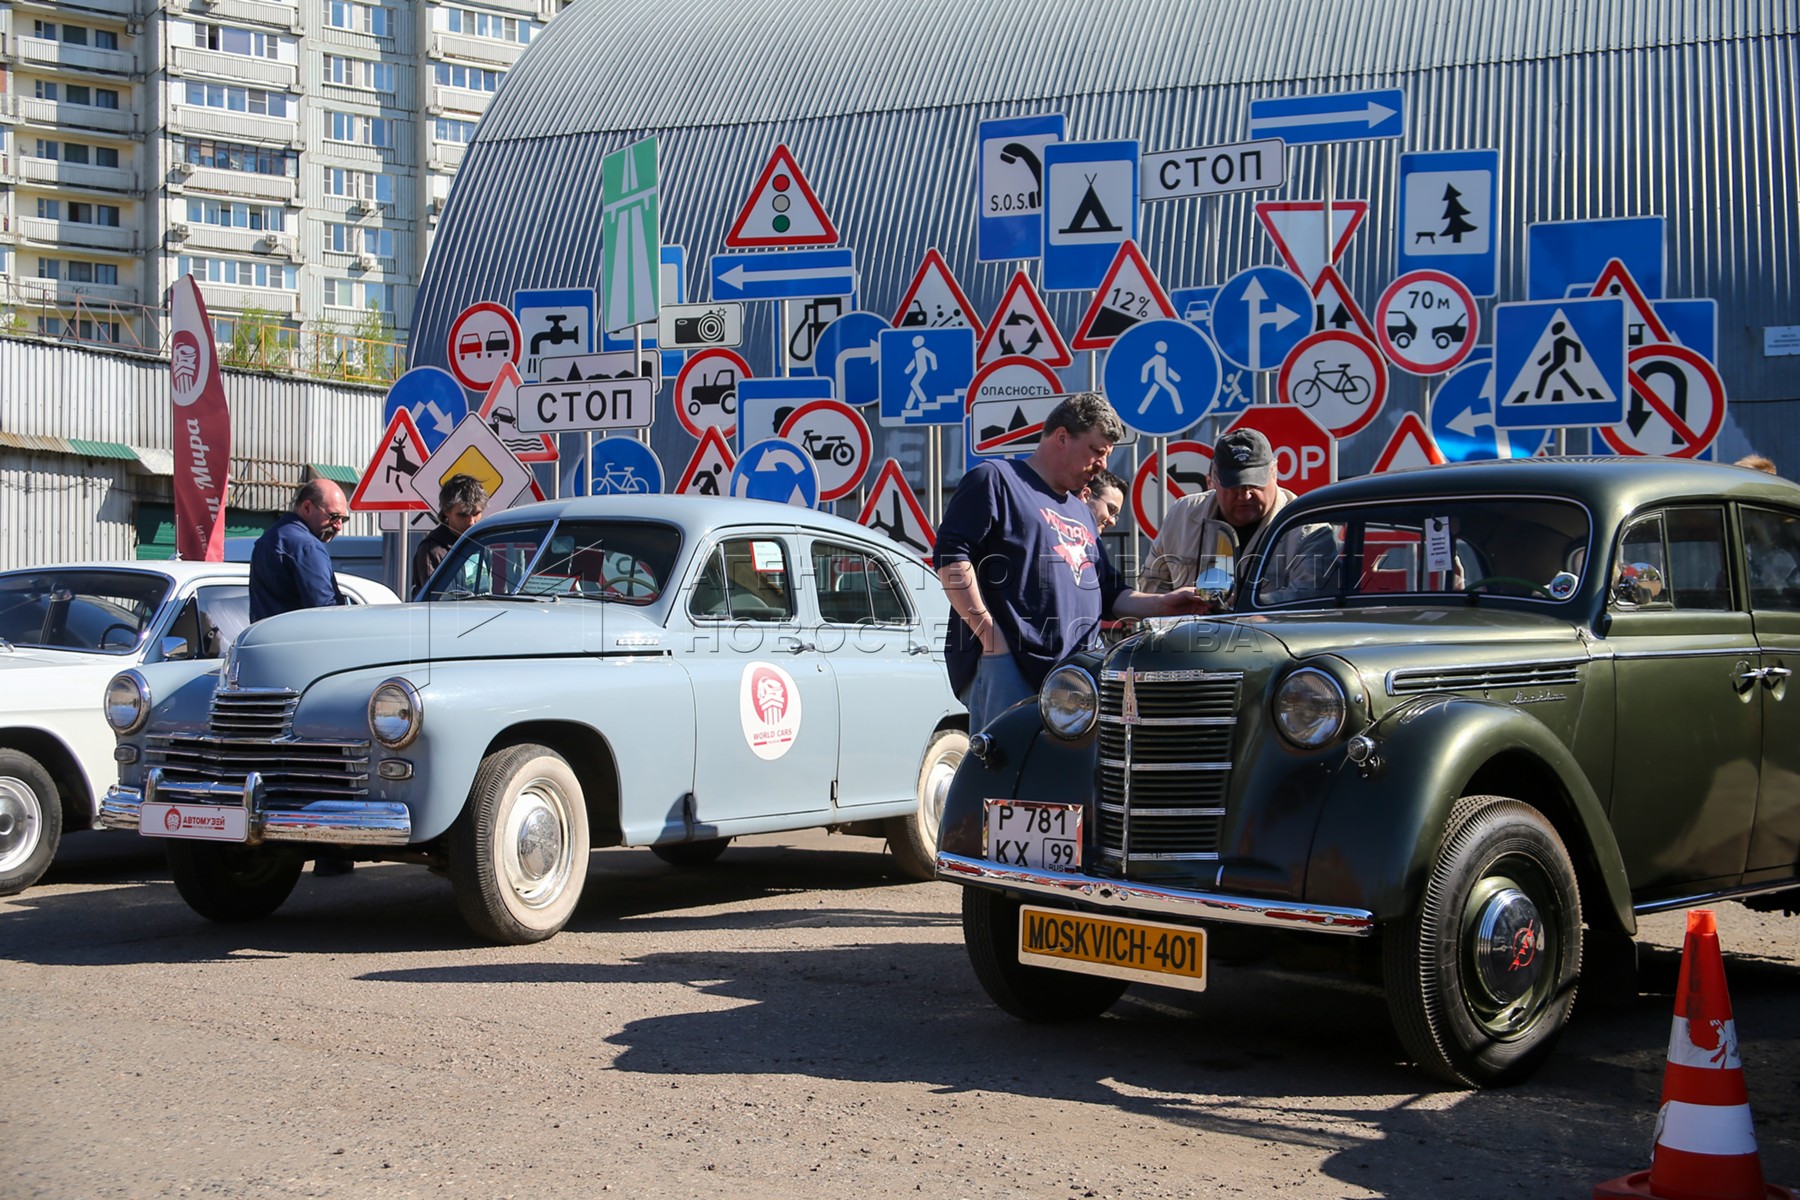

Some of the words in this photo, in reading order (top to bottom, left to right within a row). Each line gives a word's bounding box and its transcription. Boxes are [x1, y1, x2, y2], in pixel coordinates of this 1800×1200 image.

[1160, 151, 1261, 190] СТОП
[991, 193, 1028, 211] S.O.S.
[1112, 288, 1150, 317] 12%
[1408, 291, 1433, 309] 70
[981, 386, 1050, 396] ОПАСНОСТЬ
[537, 389, 632, 423] СТОП
[186, 418, 215, 490] Мира
[1273, 446, 1325, 481] OP
[753, 730, 775, 740] WORLD
[777, 728, 792, 738] CARS
[183, 815, 226, 826] АВТОМУЗЕЙ
[1024, 808, 1065, 835] 781
[1050, 843, 1073, 866] 99
[1048, 864, 1064, 873] RUS
[1029, 915, 1197, 972] MOSKVICH-401
